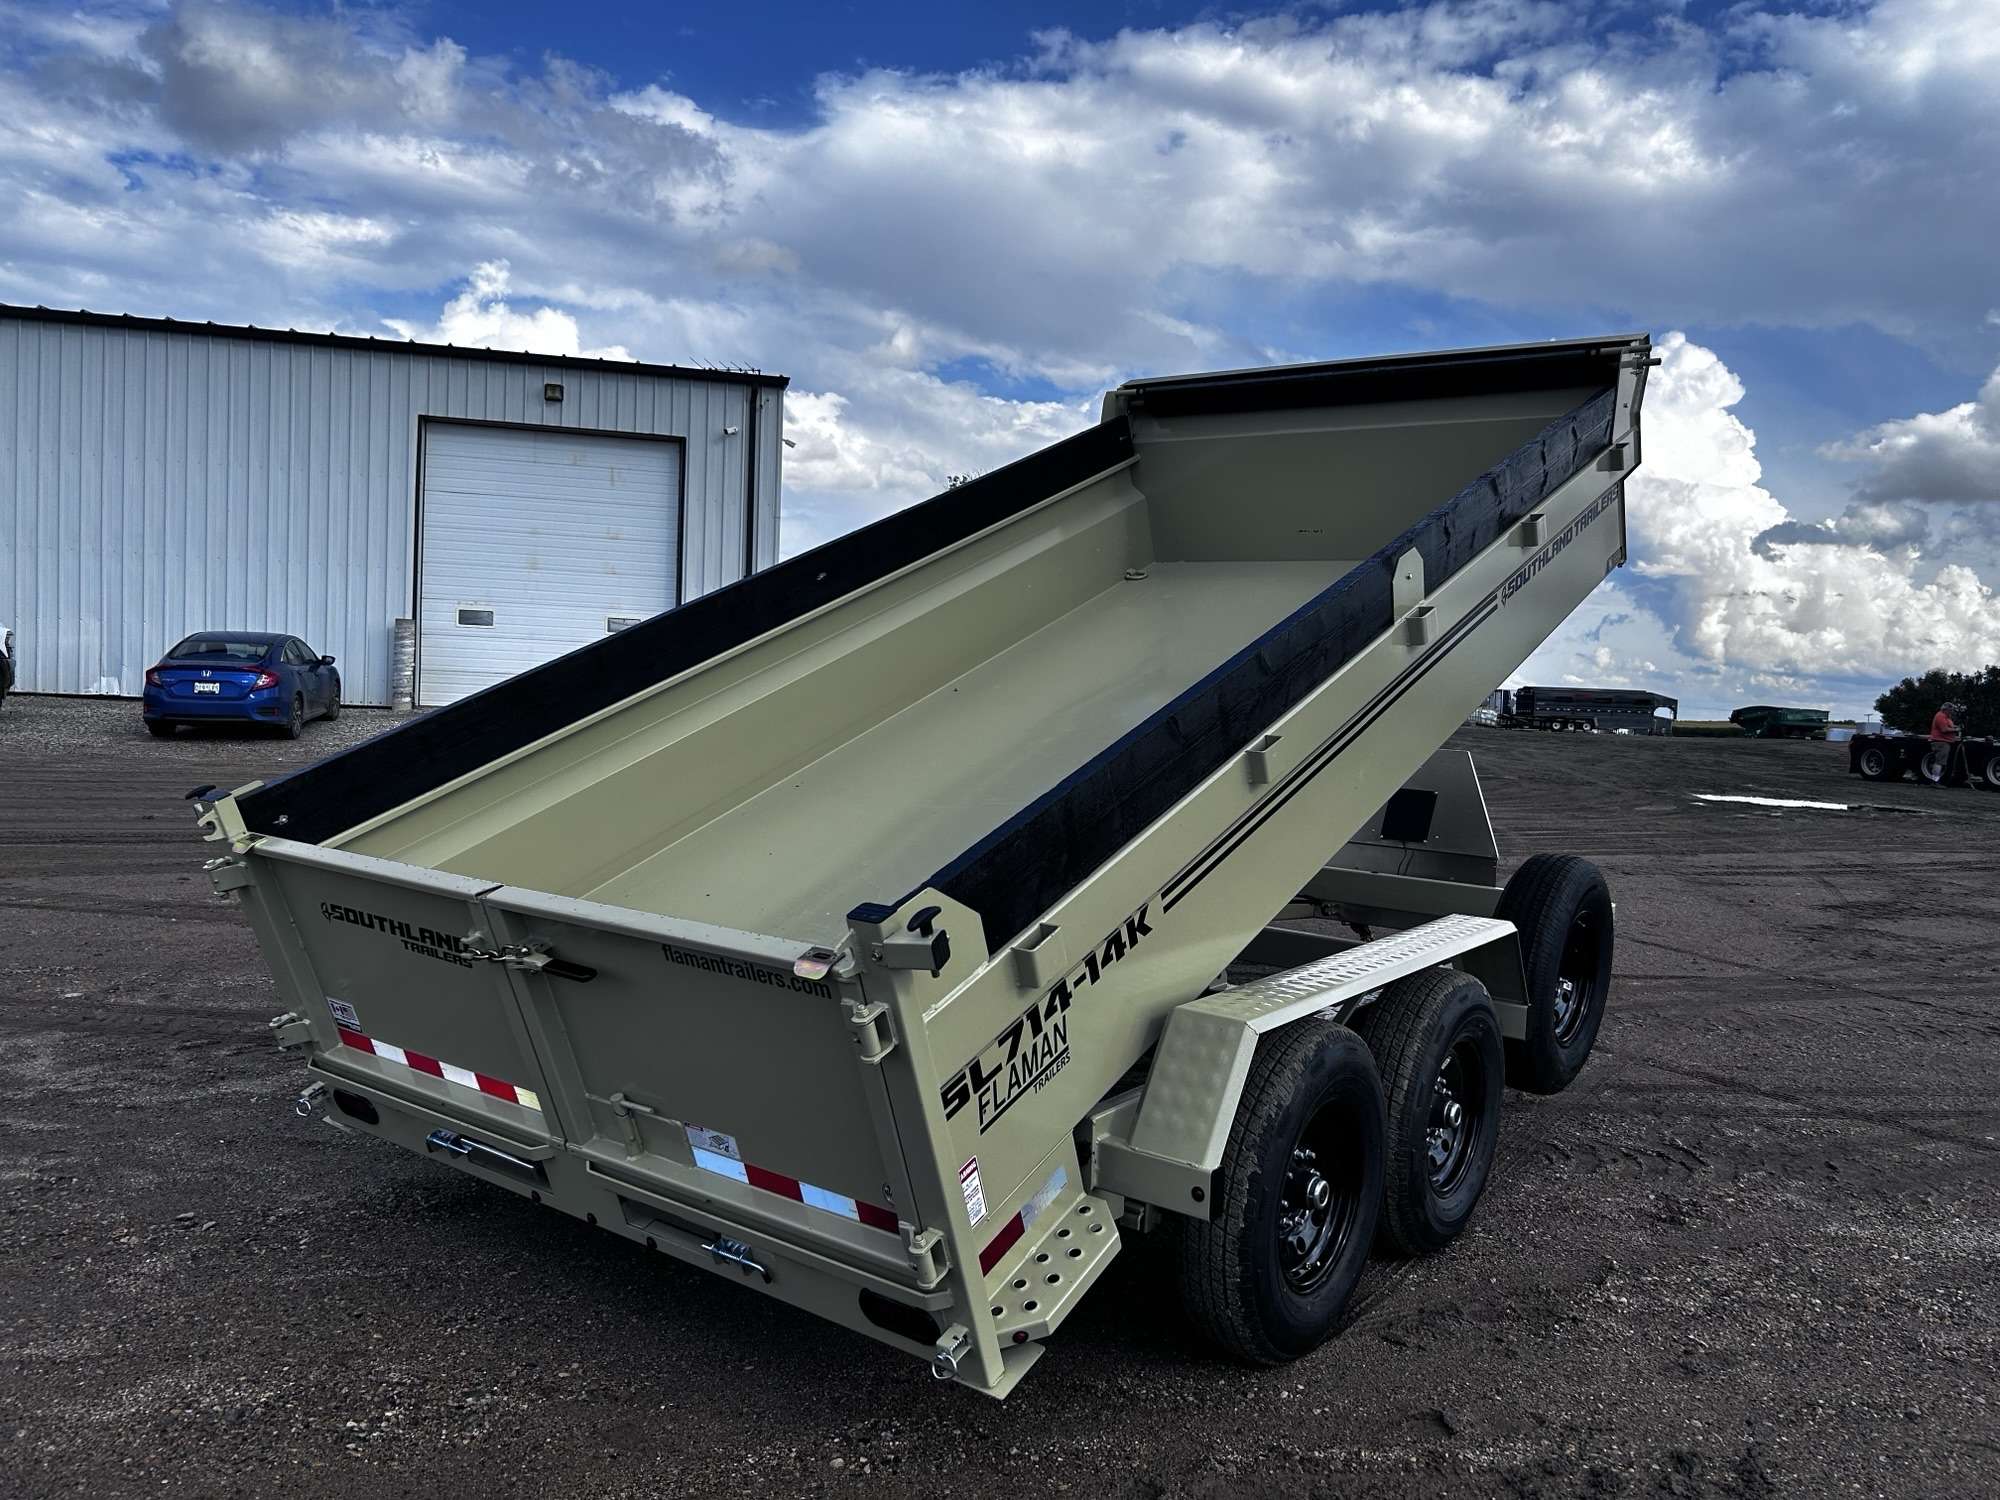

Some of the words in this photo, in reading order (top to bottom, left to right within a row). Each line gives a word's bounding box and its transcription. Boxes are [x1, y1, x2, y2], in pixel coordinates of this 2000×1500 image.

[1507, 527, 1573, 600] SOUTHLAND
[1574, 484, 1619, 536] TRAILERS
[662, 943, 832, 999] flamantrailers.com
[979, 1013, 1068, 1127] FLAMAN
[1033, 1051, 1071, 1094] TRAILERS
